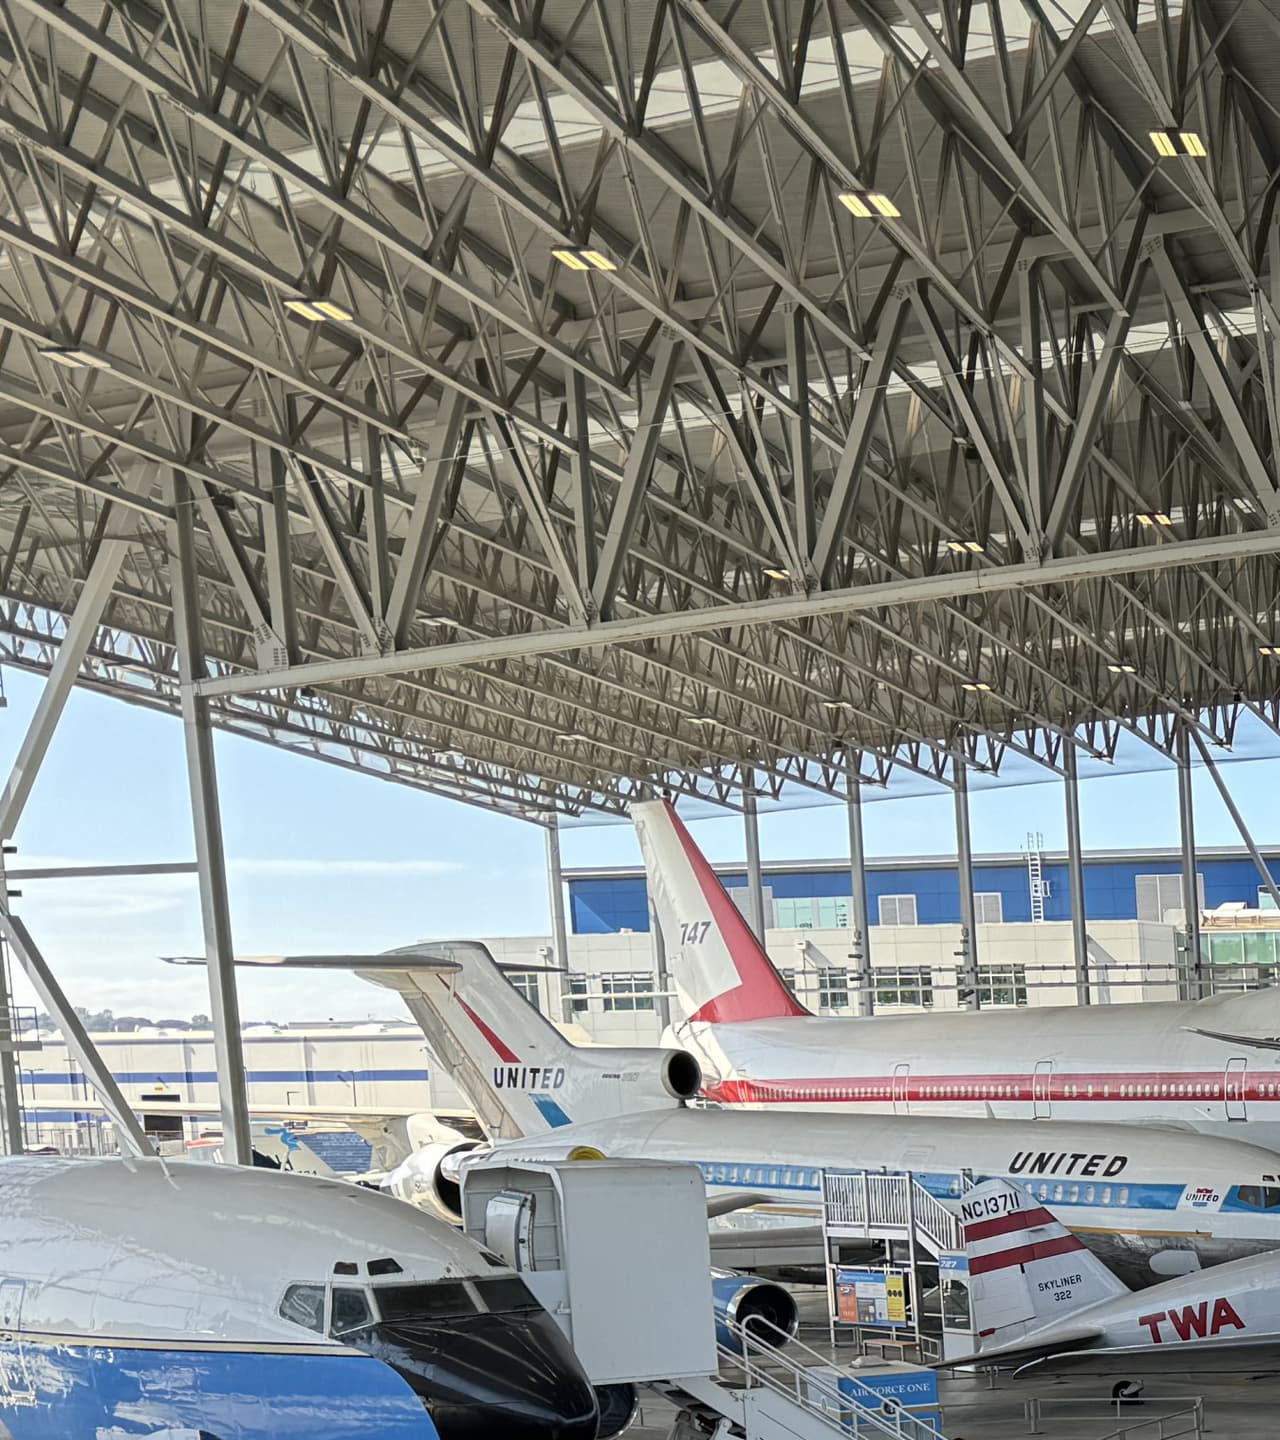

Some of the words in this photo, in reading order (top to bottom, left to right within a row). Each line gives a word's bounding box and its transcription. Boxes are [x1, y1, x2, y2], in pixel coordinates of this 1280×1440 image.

[680, 920, 711, 946] 747
[494, 1067, 565, 1089] UNITED
[1008, 1151, 1129, 1177] UNITED
[961, 1191, 1020, 1221] NC13711
[1185, 1193, 1219, 1202] UNITED
[1038, 1273, 1082, 1292] SKYLINER
[1054, 1290, 1072, 1302] 322
[1138, 1297, 1246, 1344] TWA
[907, 1383, 931, 1393] ONE
